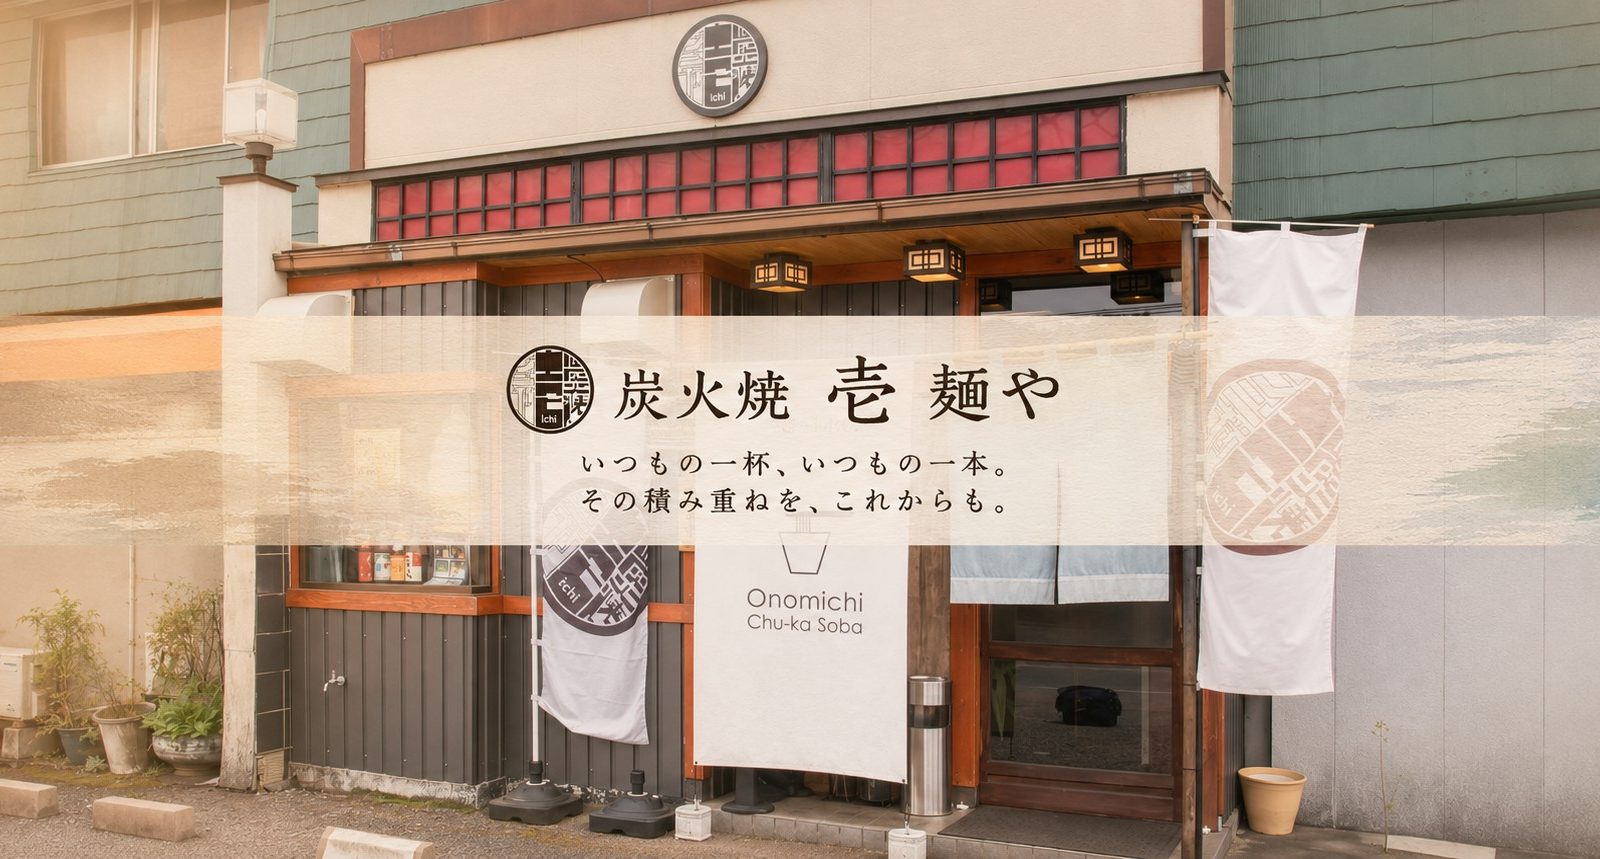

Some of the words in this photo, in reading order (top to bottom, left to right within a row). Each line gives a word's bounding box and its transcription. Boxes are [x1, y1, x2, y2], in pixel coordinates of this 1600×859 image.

[747, 588, 863, 612] Onomichi
[747, 614, 811, 632] Chu-ka
[817, 617, 863, 635] Soba
